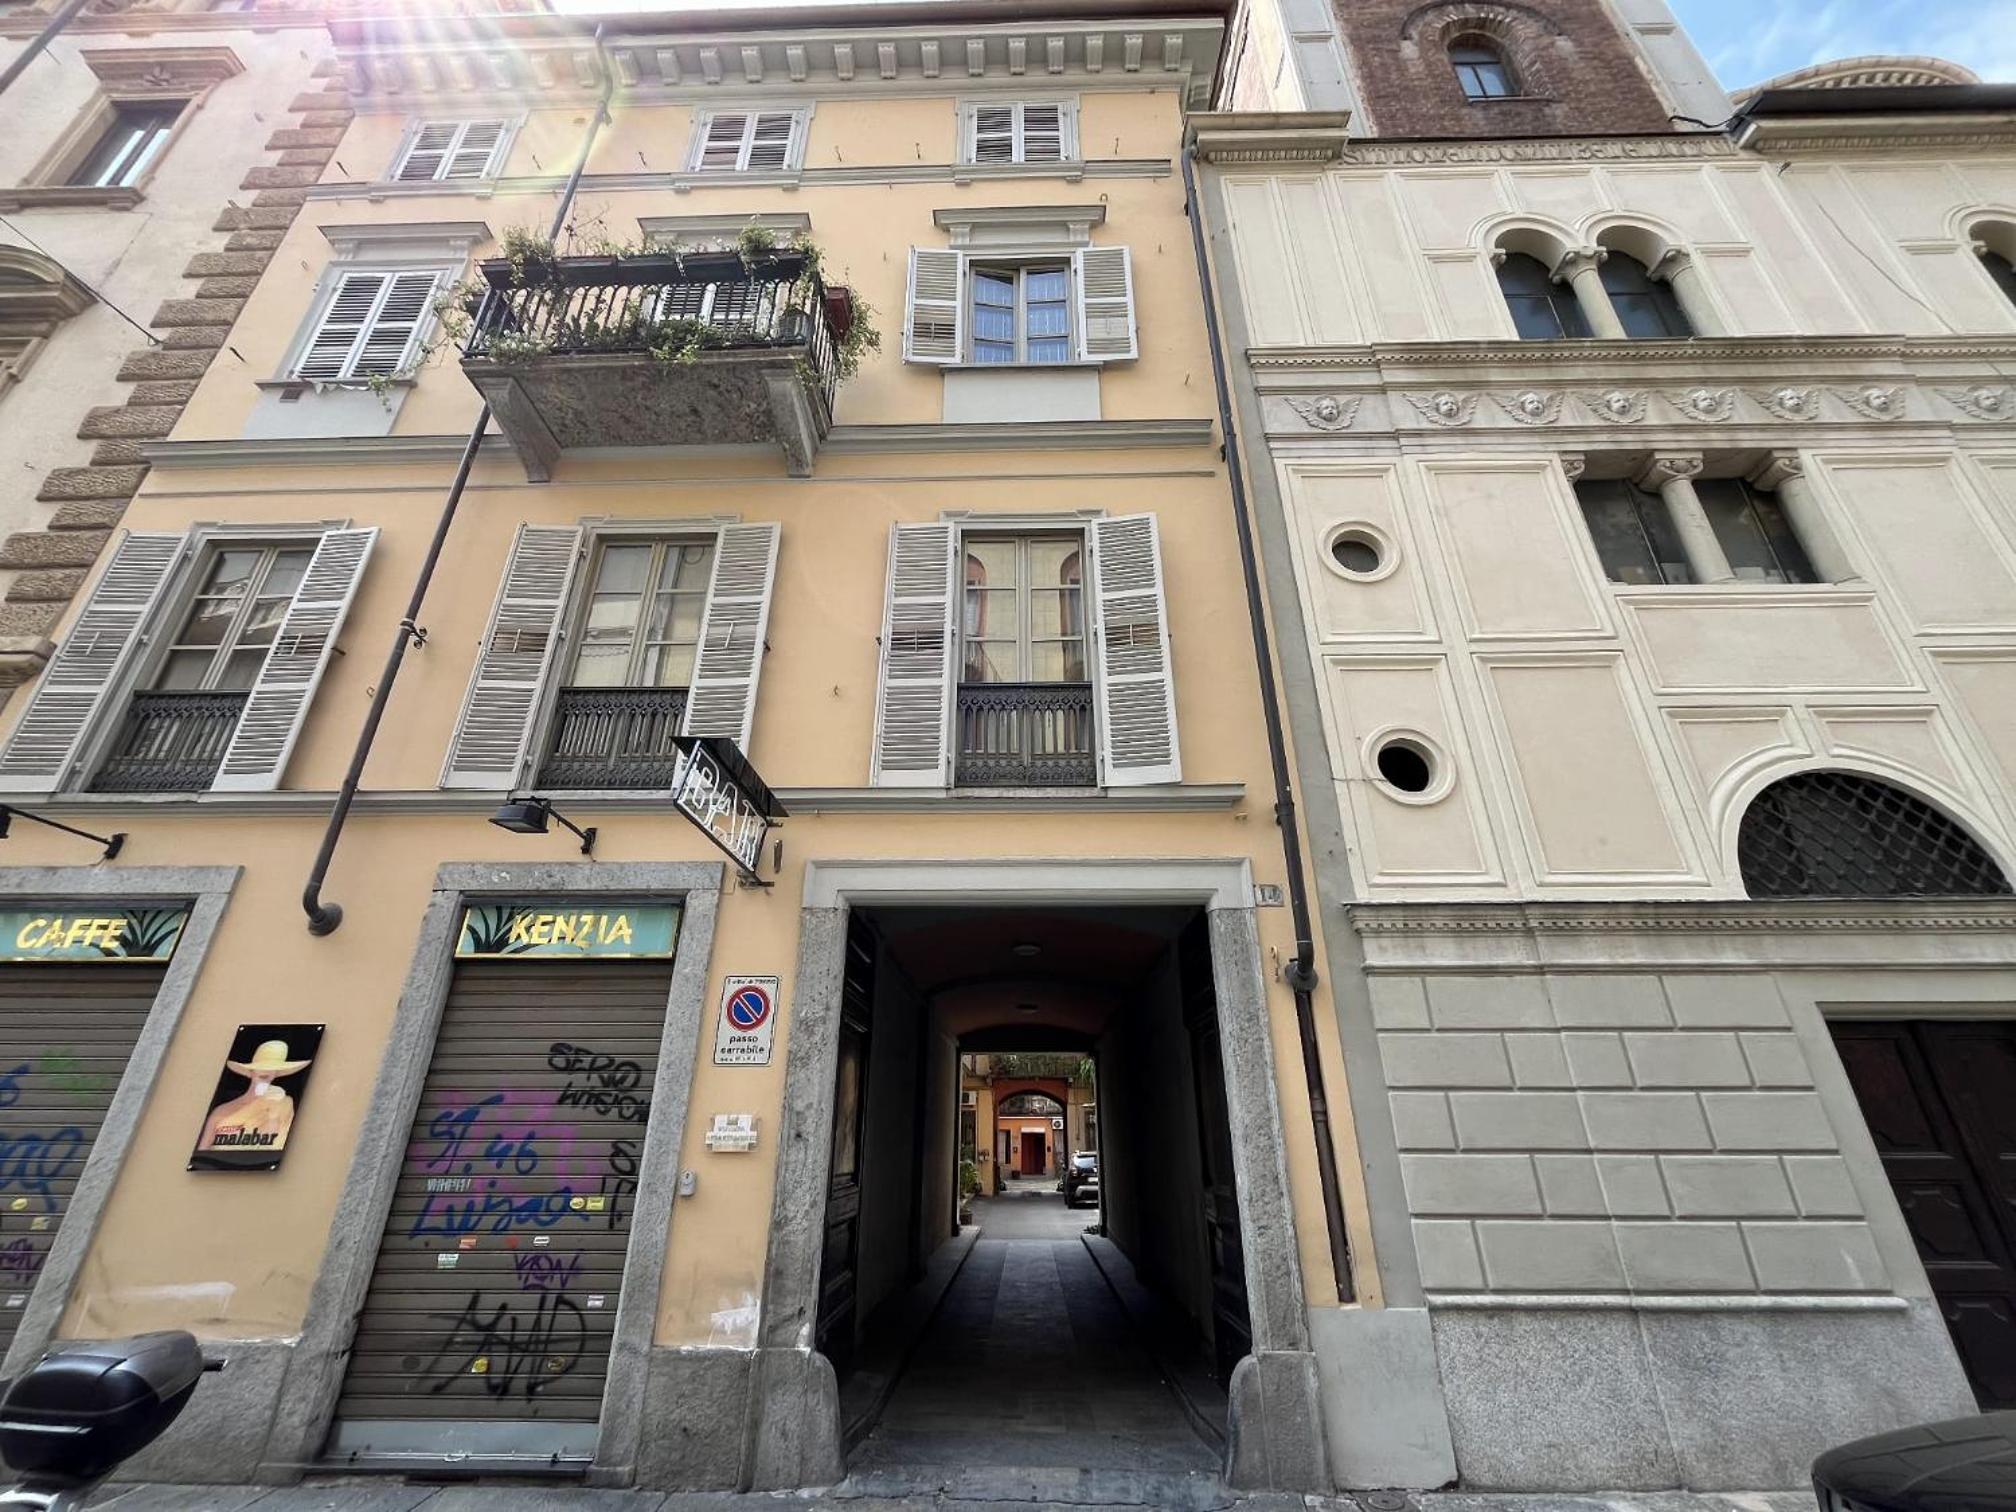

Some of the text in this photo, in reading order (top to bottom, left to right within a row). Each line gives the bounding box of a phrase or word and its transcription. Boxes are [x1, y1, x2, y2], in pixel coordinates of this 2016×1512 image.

[508, 914, 632, 948] KENZIA
[729, 1035, 759, 1044] passo
[720, 1045, 765, 1054] carrabile
[212, 1127, 279, 1146] malabar
